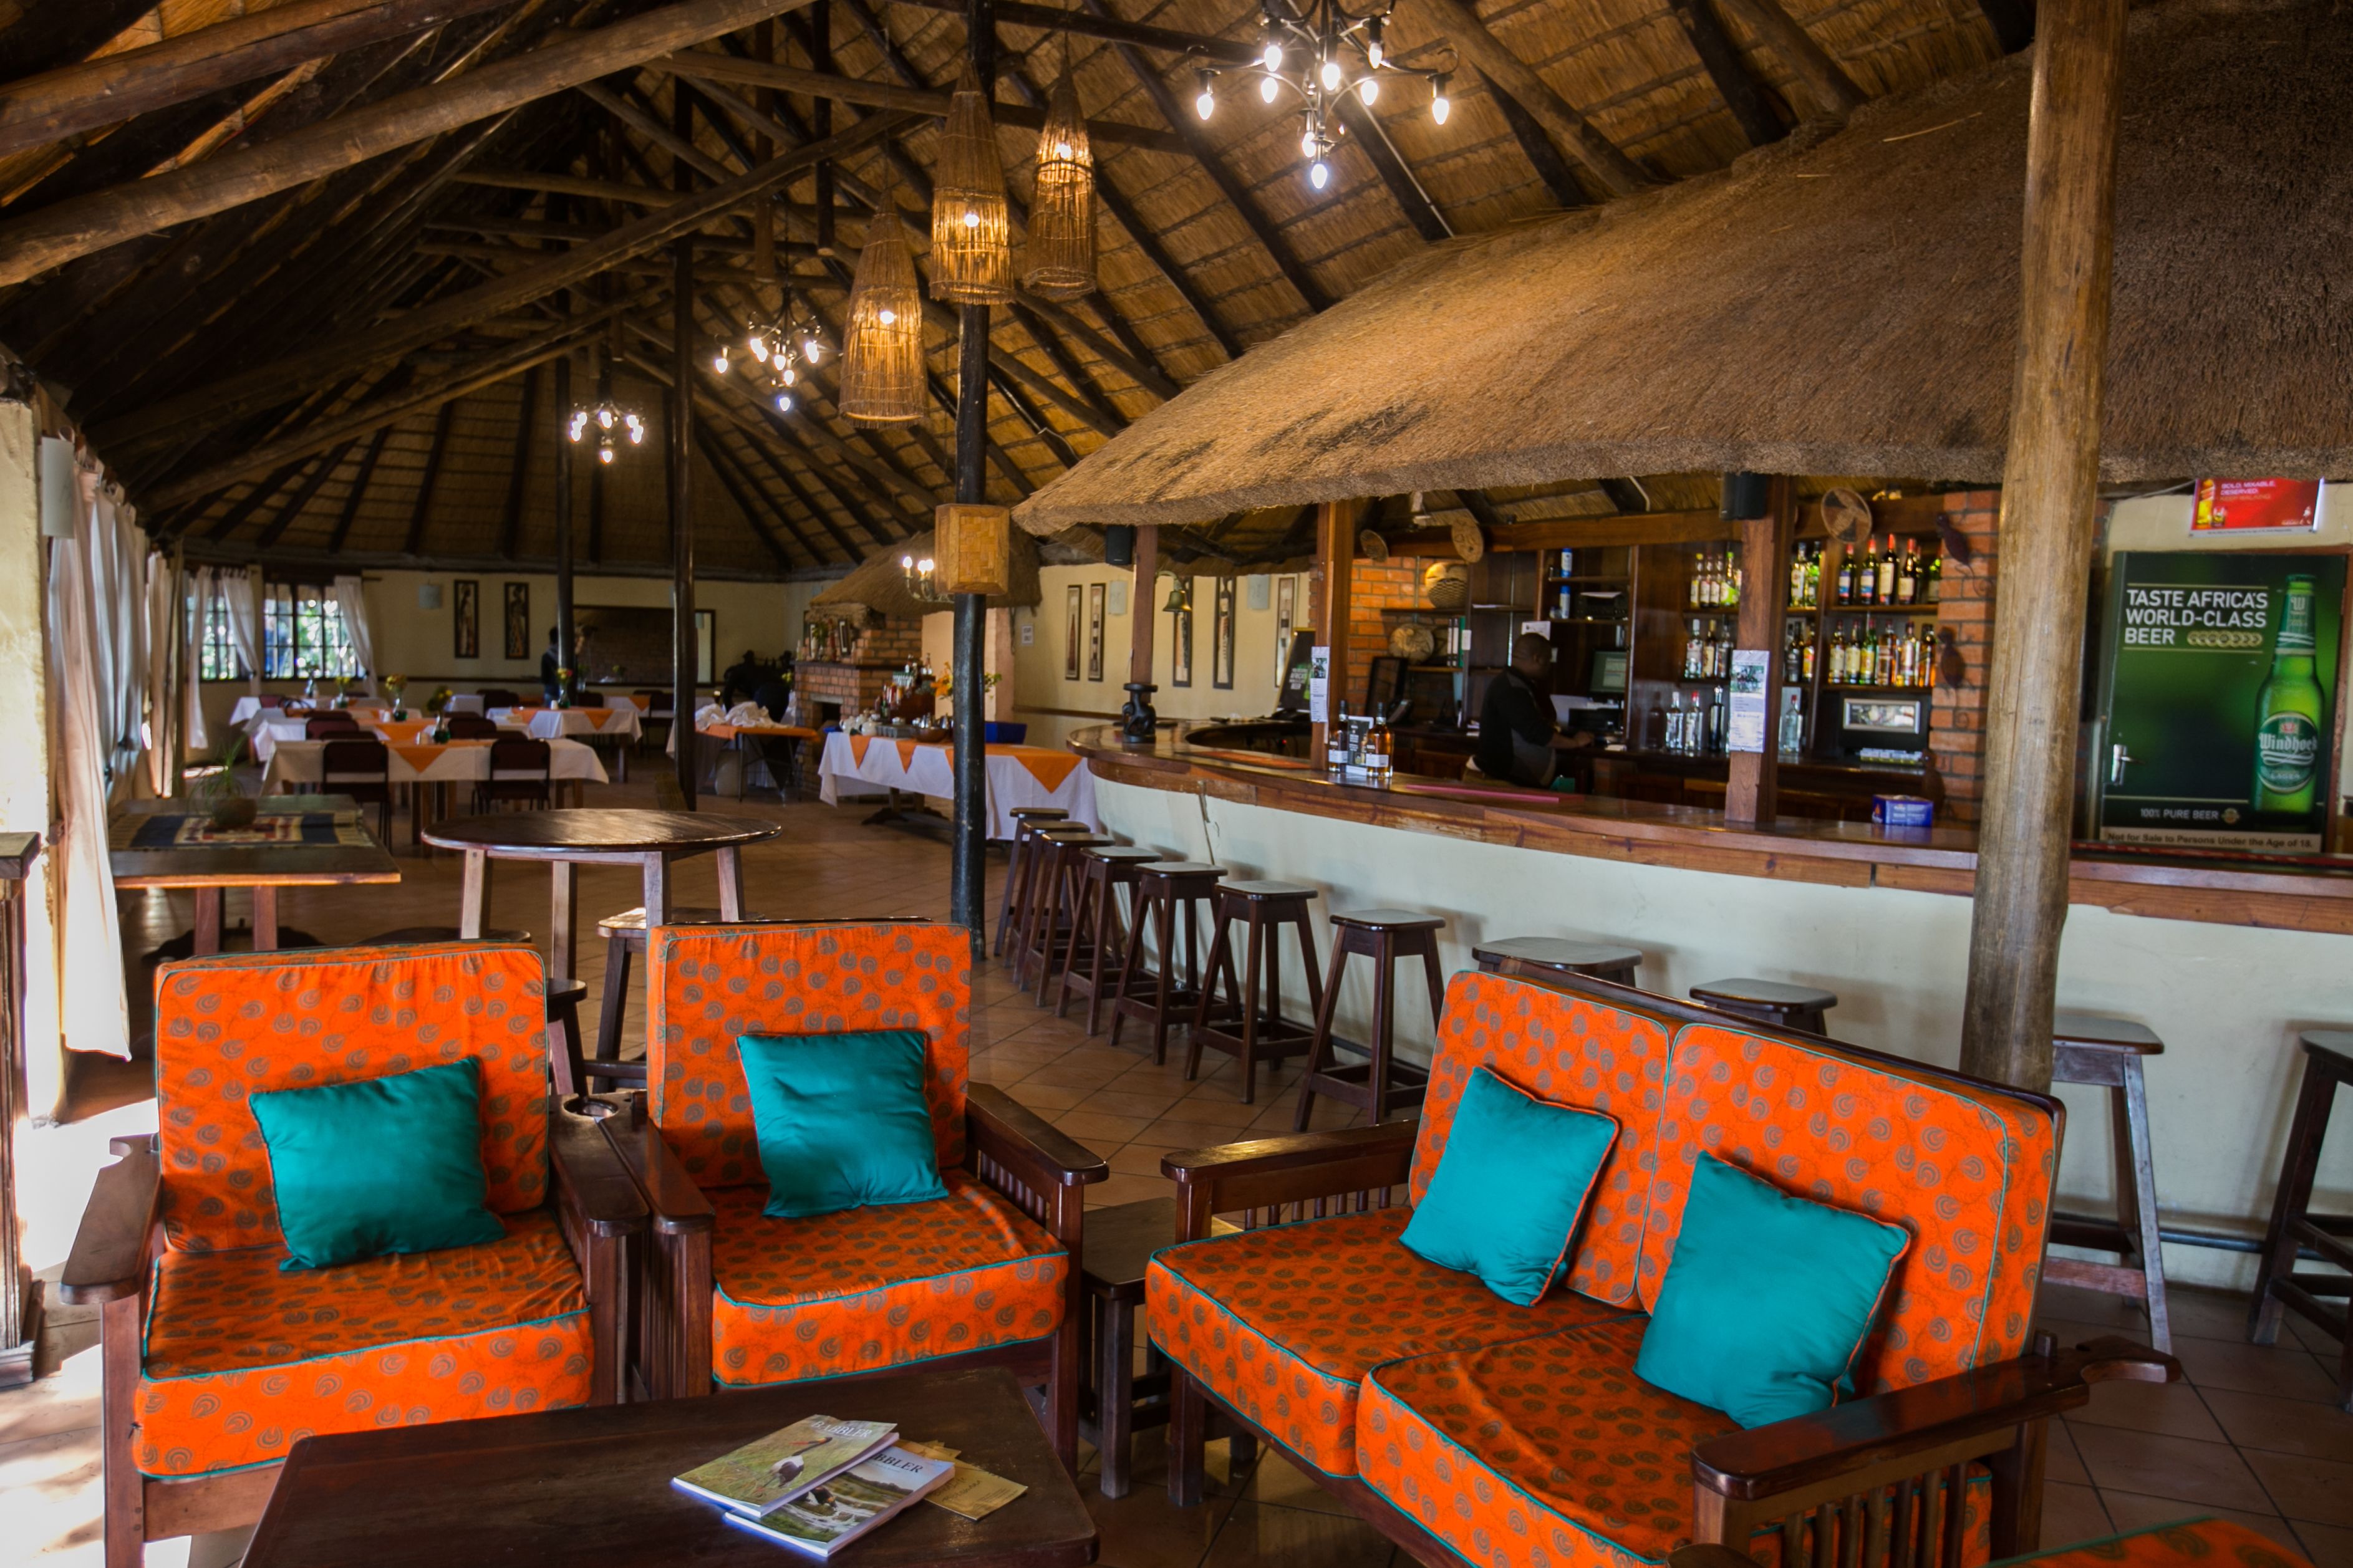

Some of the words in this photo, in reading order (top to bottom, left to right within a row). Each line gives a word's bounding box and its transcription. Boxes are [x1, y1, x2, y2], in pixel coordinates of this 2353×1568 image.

[2127, 589, 2184, 607] TASTE
[2187, 591, 2268, 608] AFRICA'S
[2125, 608, 2267, 628] WORLD-CLASS
[2124, 627, 2175, 645] BEER
[2258, 733, 2317, 754] Windhoek
[2140, 808, 2160, 818] 100%
[2163, 809, 2190, 819] PURE
[2192, 809, 2219, 820] BEER
[2107, 832, 2124, 841] Not
[2127, 833, 2140, 841] for
[2142, 834, 2162, 842] Sale
[2165, 834, 2175, 842] to
[2177, 835, 2215, 844] Persons
[2218, 836, 2246, 845] Under
[2249, 837, 2264, 846] the
[2266, 839, 2284, 849] Age
[2287, 839, 2297, 847] of
[812, 1421, 872, 1438] BABBLER
[872, 1453, 923, 1473] BBLER
